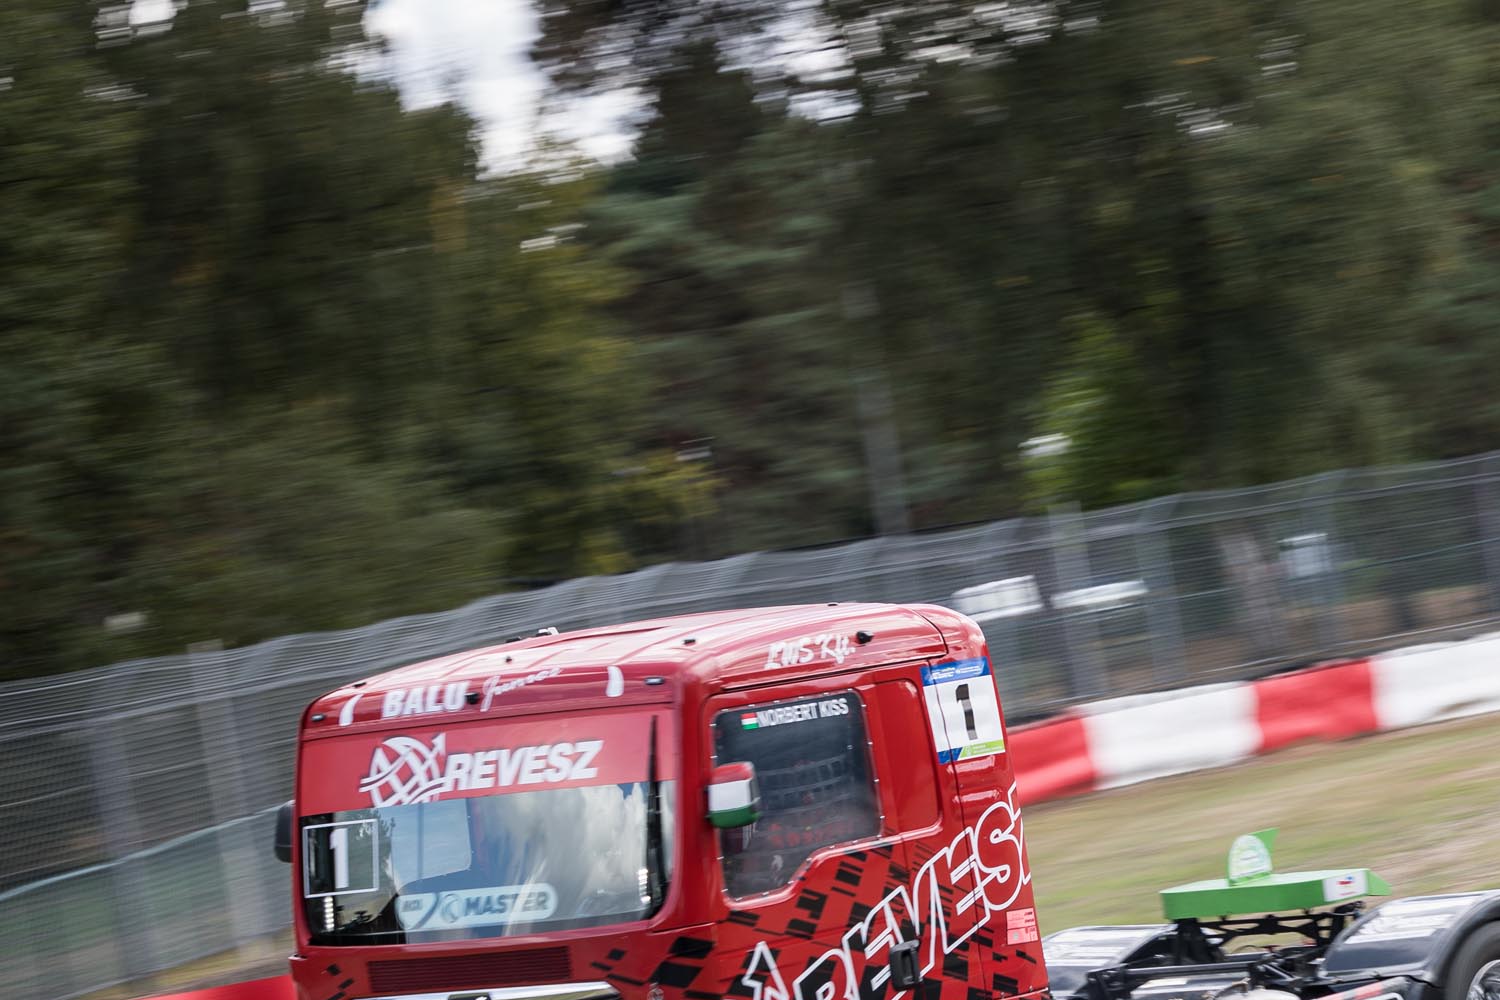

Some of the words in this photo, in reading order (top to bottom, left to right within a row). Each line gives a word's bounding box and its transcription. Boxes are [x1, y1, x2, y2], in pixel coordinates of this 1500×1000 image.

[381, 680, 471, 719] BALU
[756, 702, 818, 728] NORBERT
[818, 697, 849, 718] KISS
[955, 683, 978, 741] 1
[446, 740, 604, 791] REVESZ
[329, 827, 349, 889] 1
[465, 890, 548, 917] MASTER
